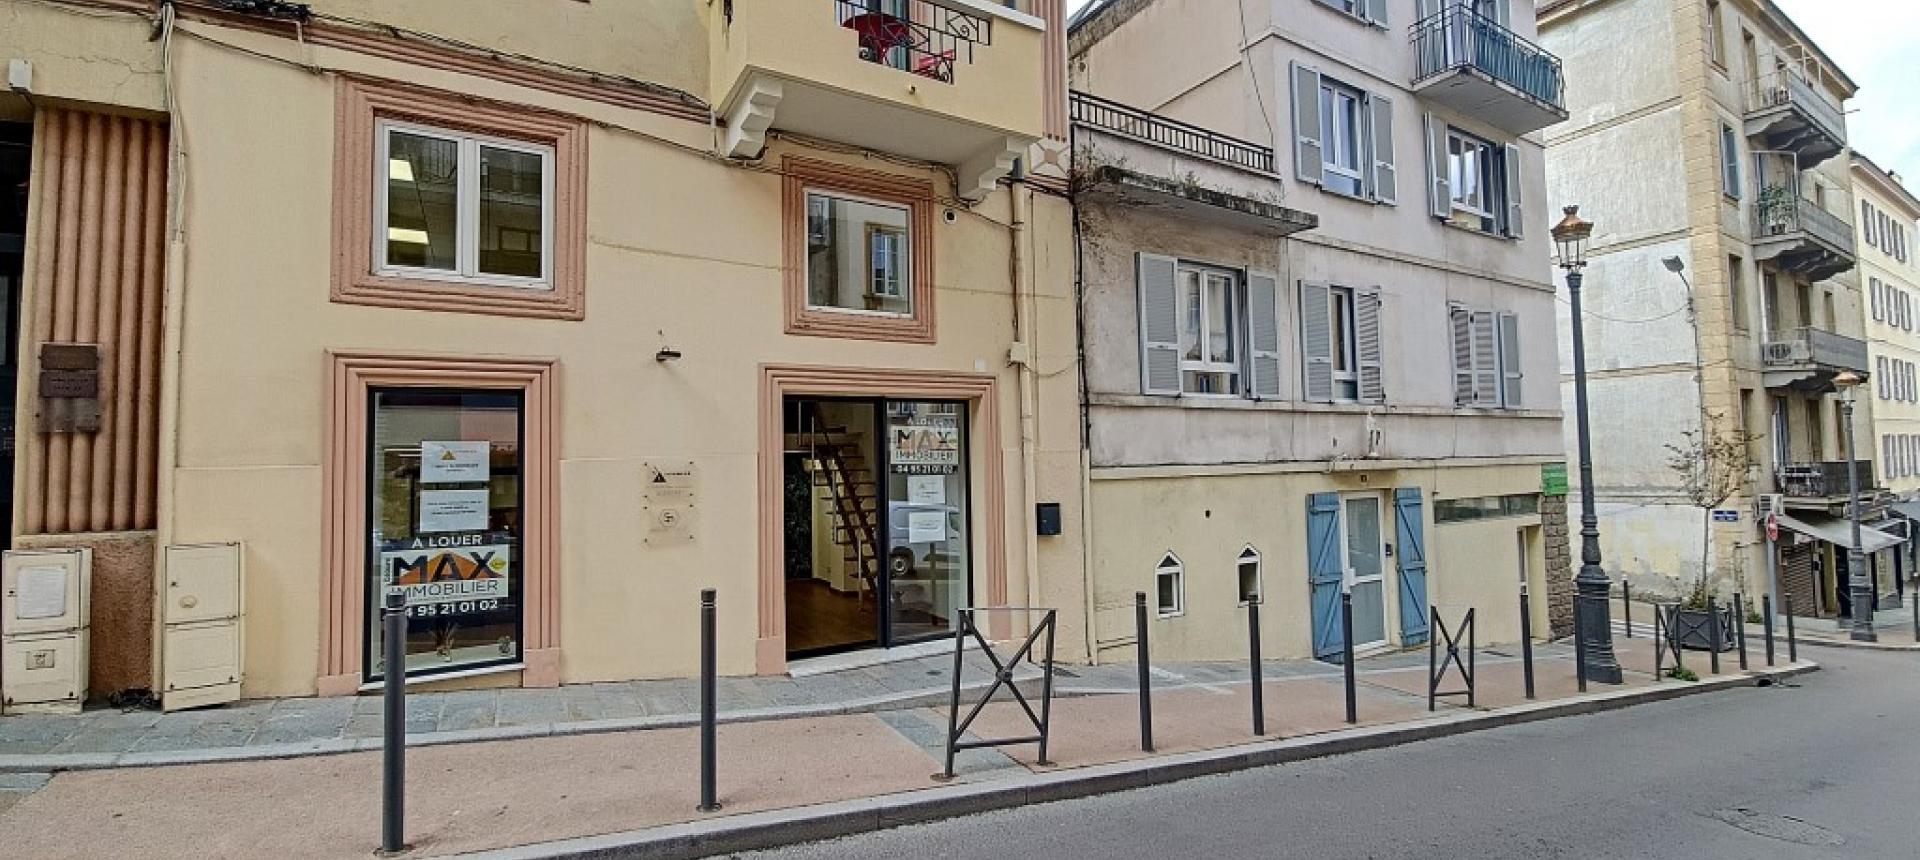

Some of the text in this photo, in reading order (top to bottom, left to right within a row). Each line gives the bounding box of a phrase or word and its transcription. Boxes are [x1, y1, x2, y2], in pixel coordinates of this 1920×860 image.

[896, 430, 955, 450] MAX
[896, 450, 953, 461] IMMOBILIER
[411, 535, 483, 549] A LOUER
[393, 551, 503, 585] MAX
[417, 604, 436, 616] 95
[441, 603, 455, 614] 21
[460, 601, 475, 612] 01
[479, 600, 498, 611] 02
